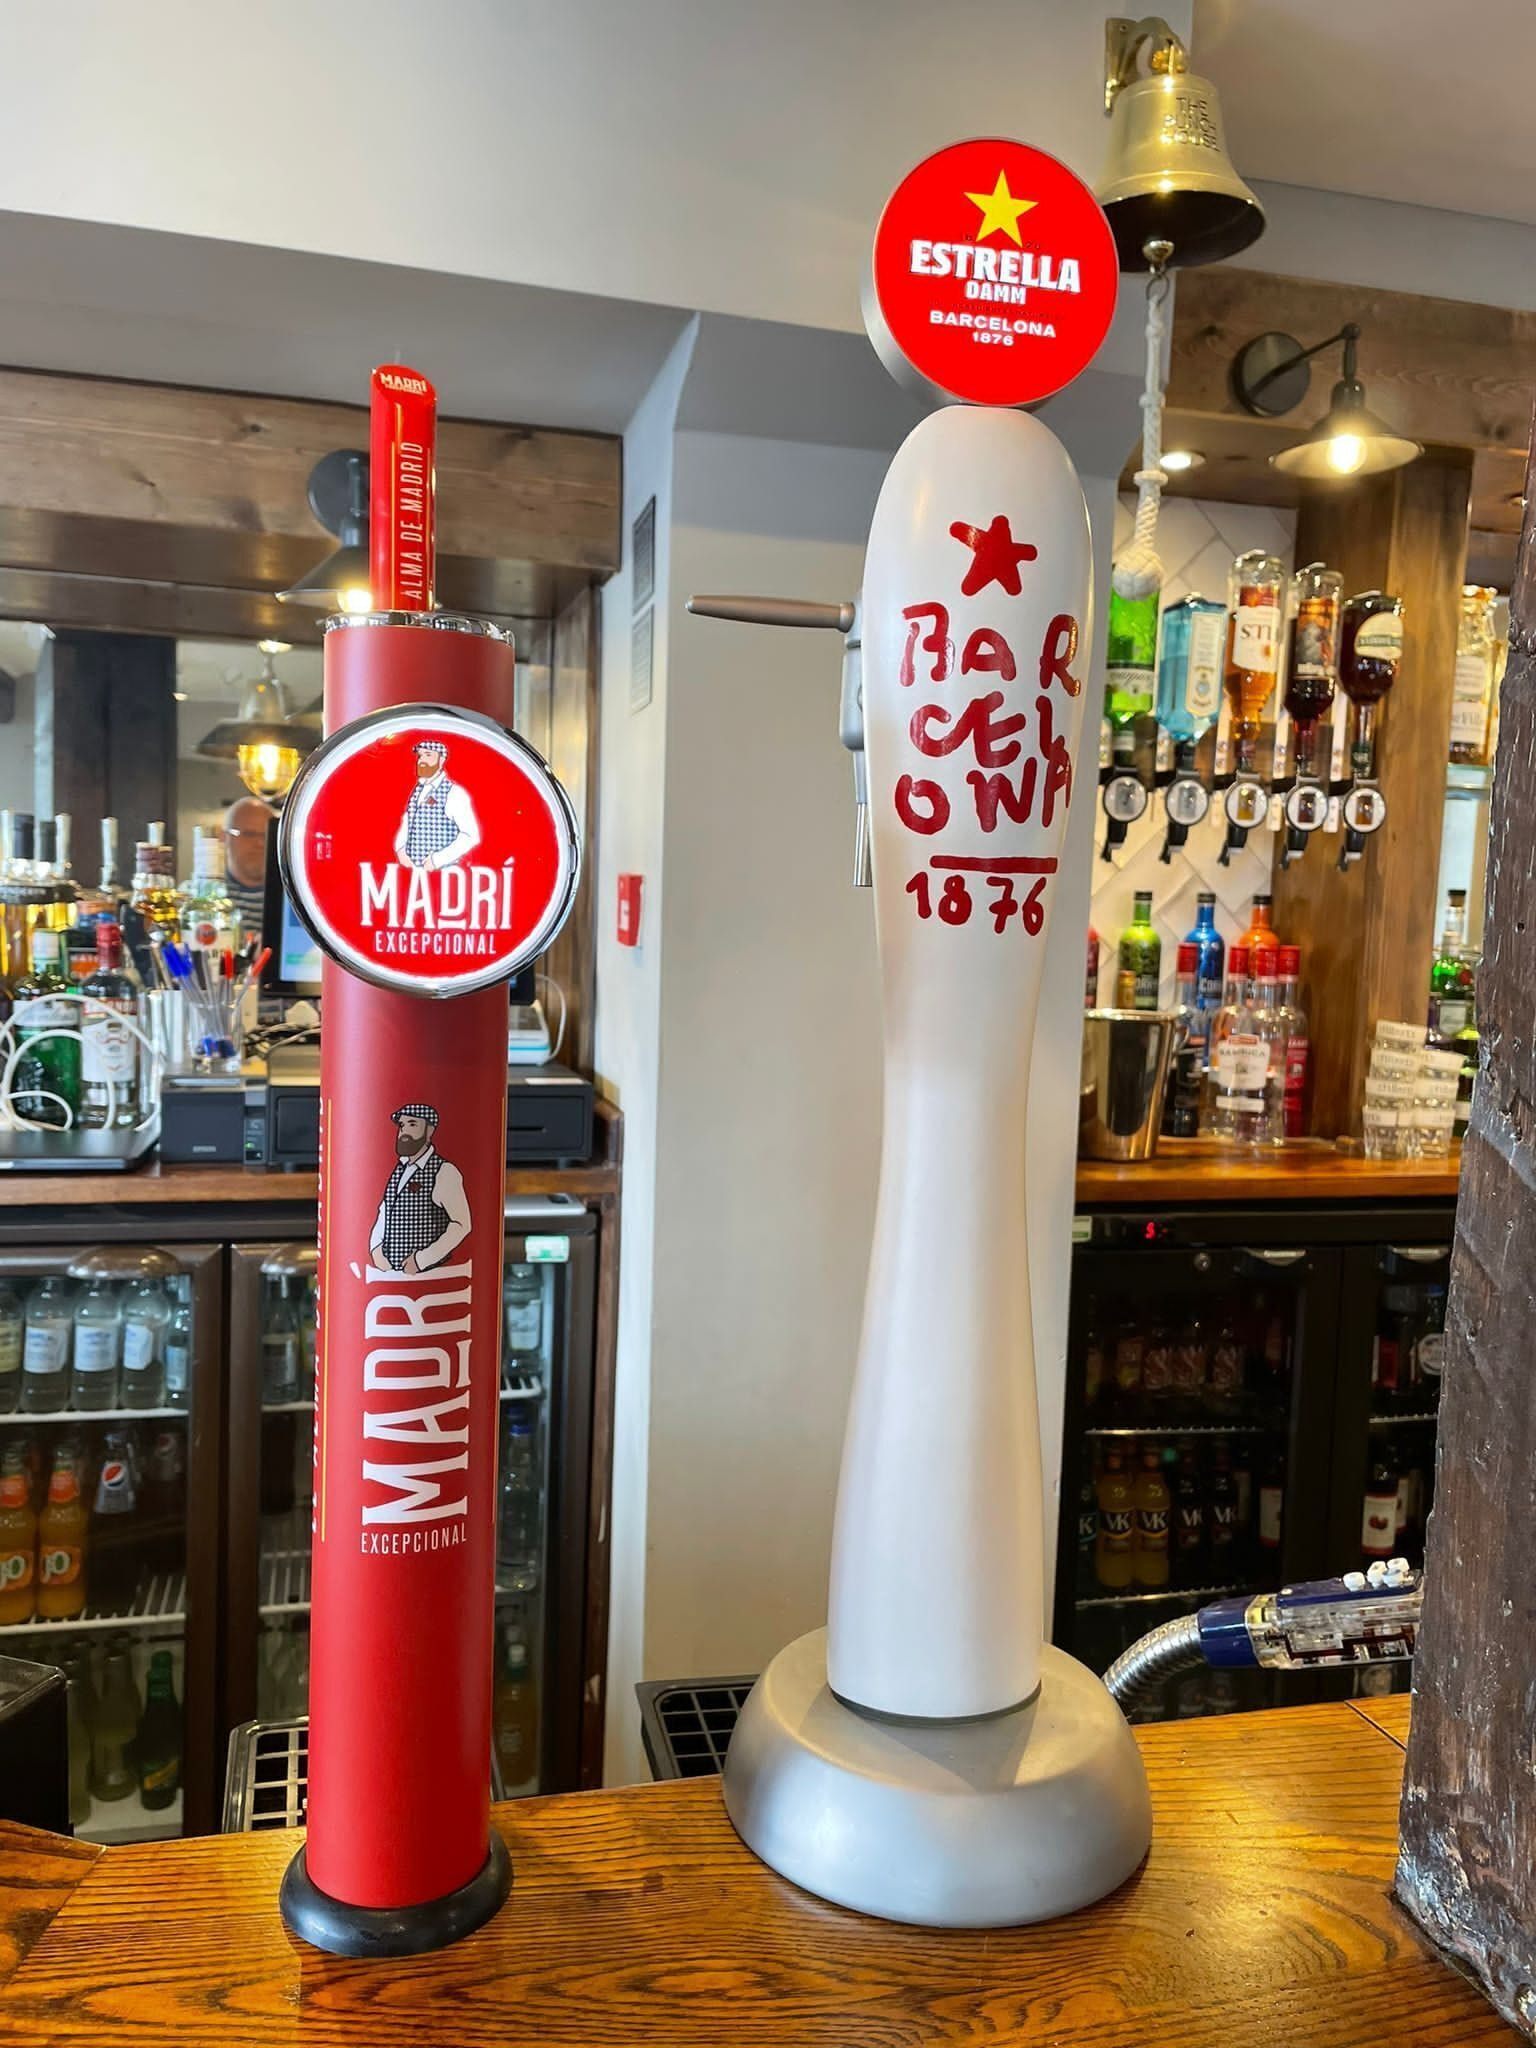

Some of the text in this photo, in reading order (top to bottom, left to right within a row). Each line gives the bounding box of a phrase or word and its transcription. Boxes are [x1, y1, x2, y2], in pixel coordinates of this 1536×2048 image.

[910, 239, 1081, 294] ESTRELLA
[965, 280, 1027, 305] DAMM
[929, 310, 1057, 338] BARCELONA
[972, 331, 1014, 346] 1876
[400, 442, 423, 600] ALMA DE MADRID
[359, 856, 514, 930] MADRÍ
[906, 871, 1047, 936] 1876
[375, 930, 497, 955] EXCEPCIONAL
[350, 1258, 472, 1526] MADRÍ
[1105, 1512, 1130, 1532] VK
[1142, 1511, 1167, 1531] VK
[361, 1521, 467, 1555] EXCEPCIONAL
